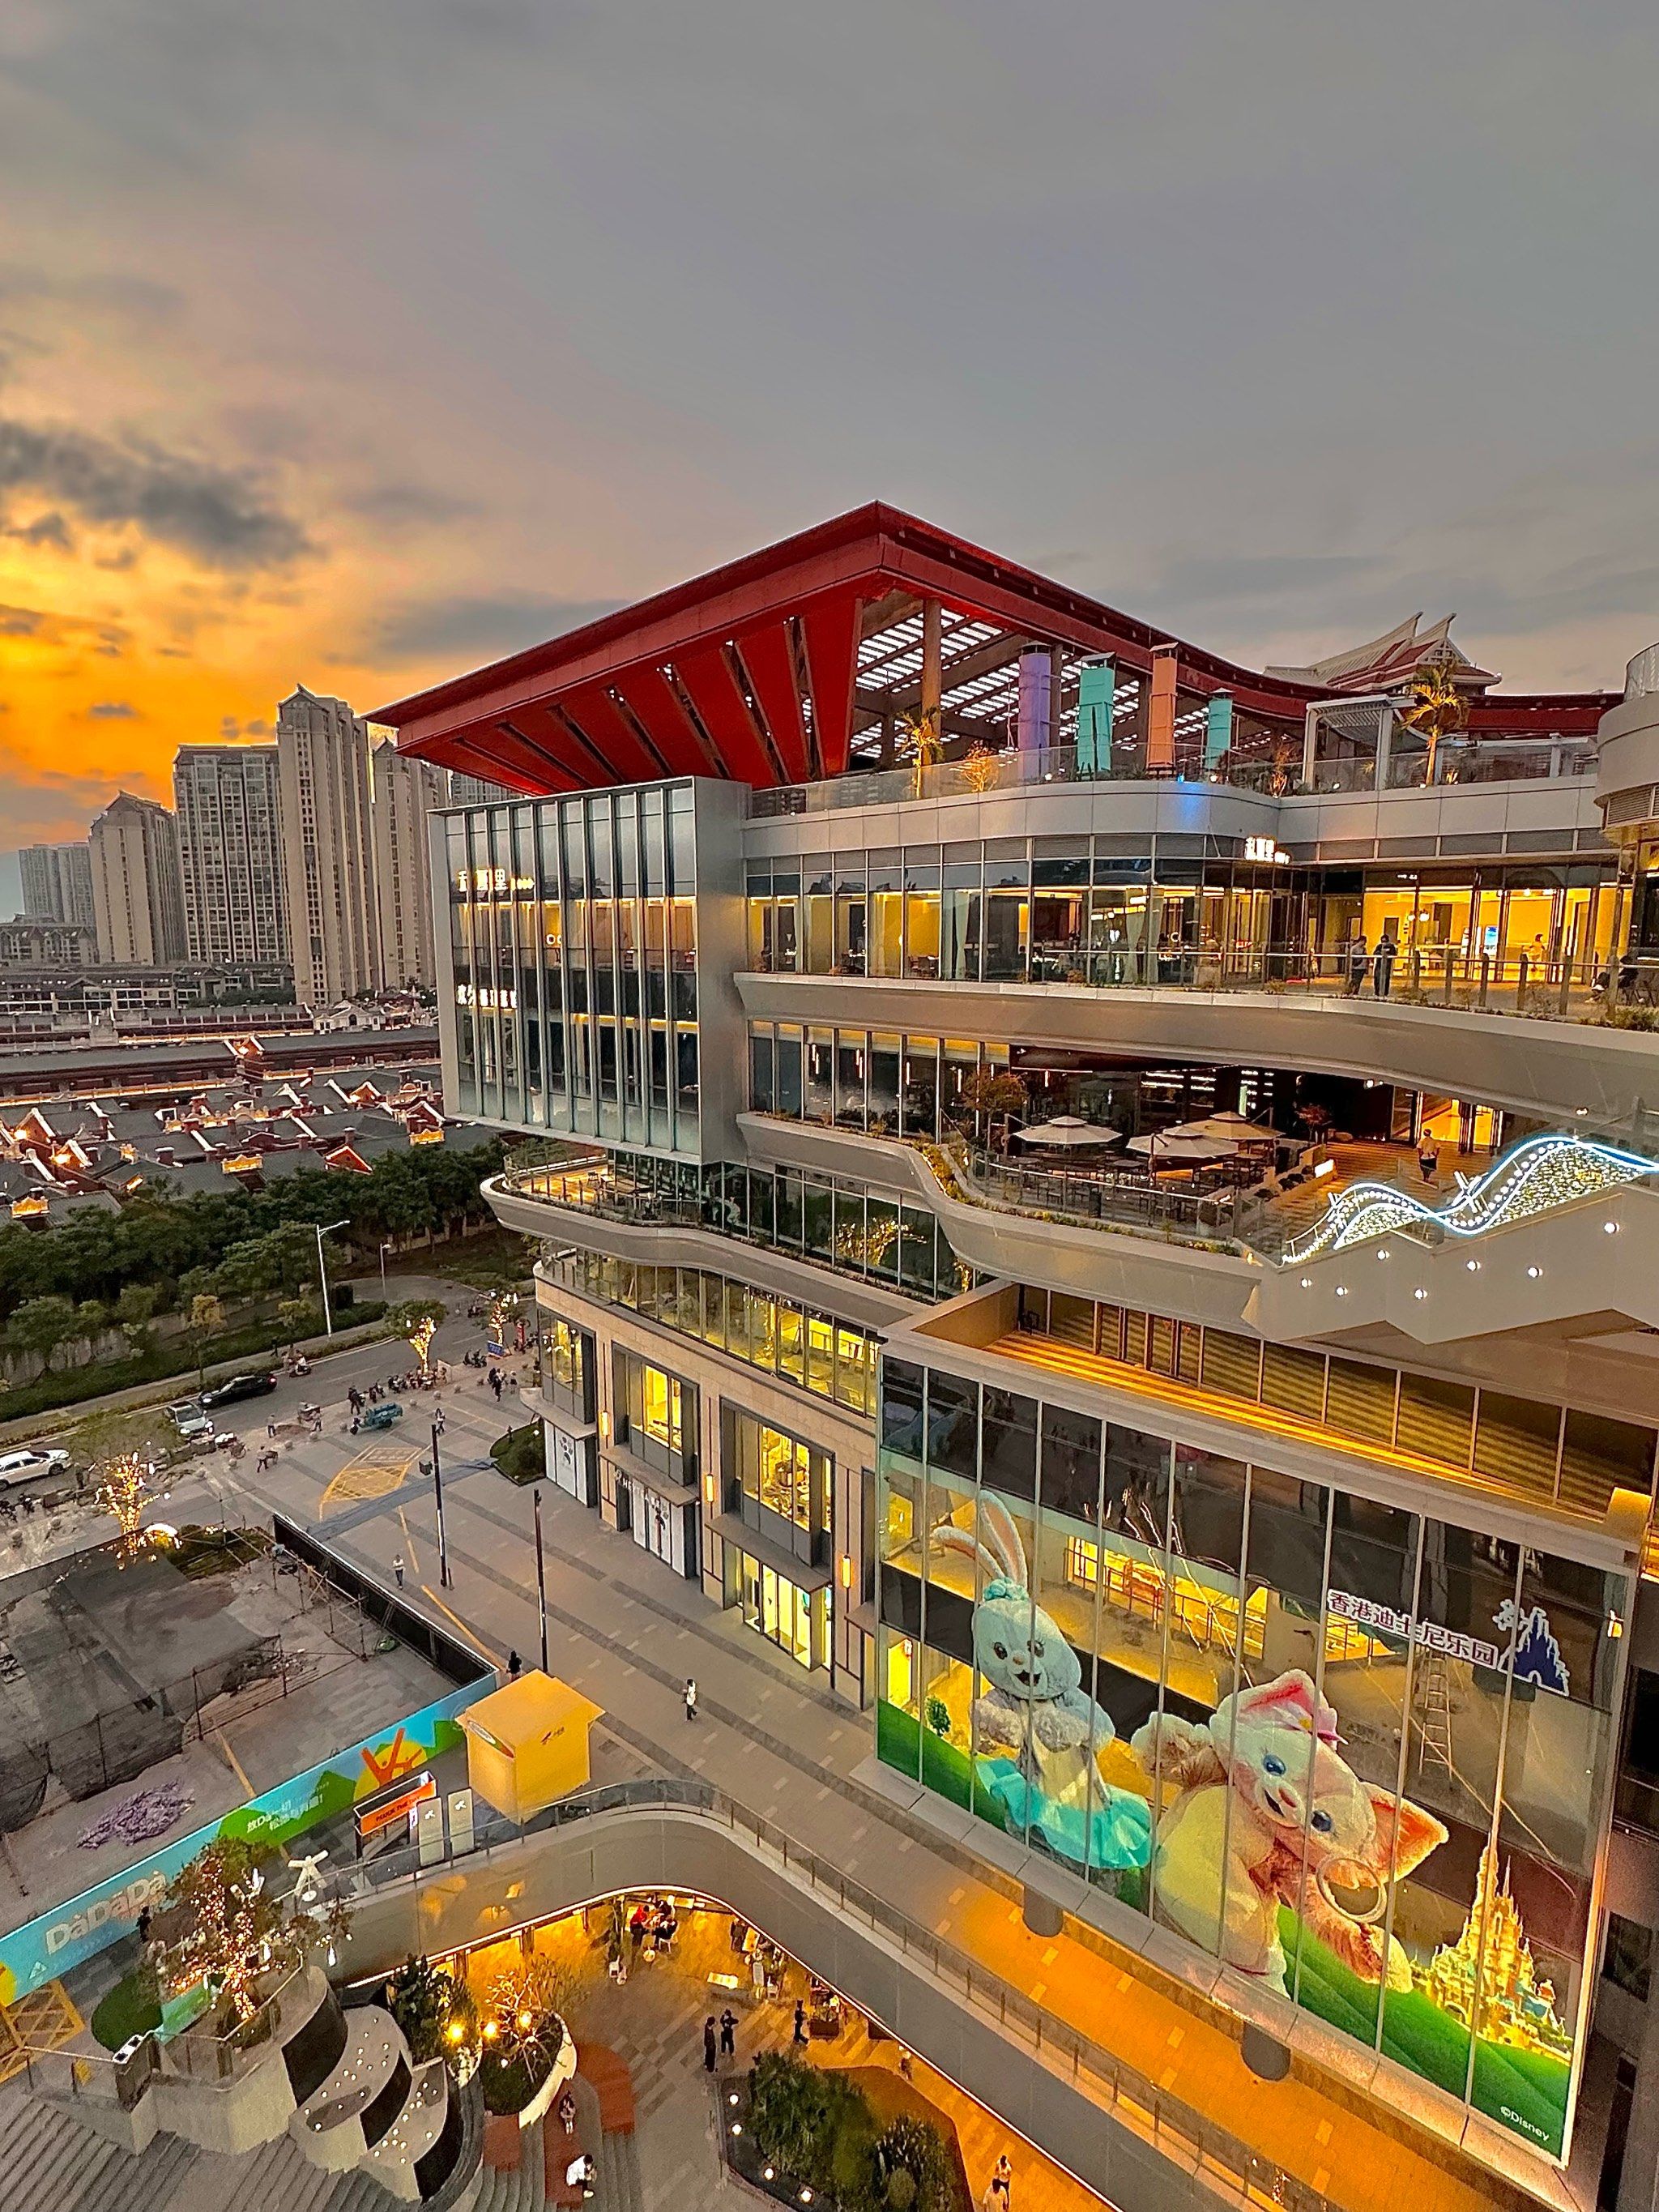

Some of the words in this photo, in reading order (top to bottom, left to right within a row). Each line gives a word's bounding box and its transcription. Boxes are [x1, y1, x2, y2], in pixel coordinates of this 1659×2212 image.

[1328, 1591, 1496, 1667] 香港迪士尼乐园
